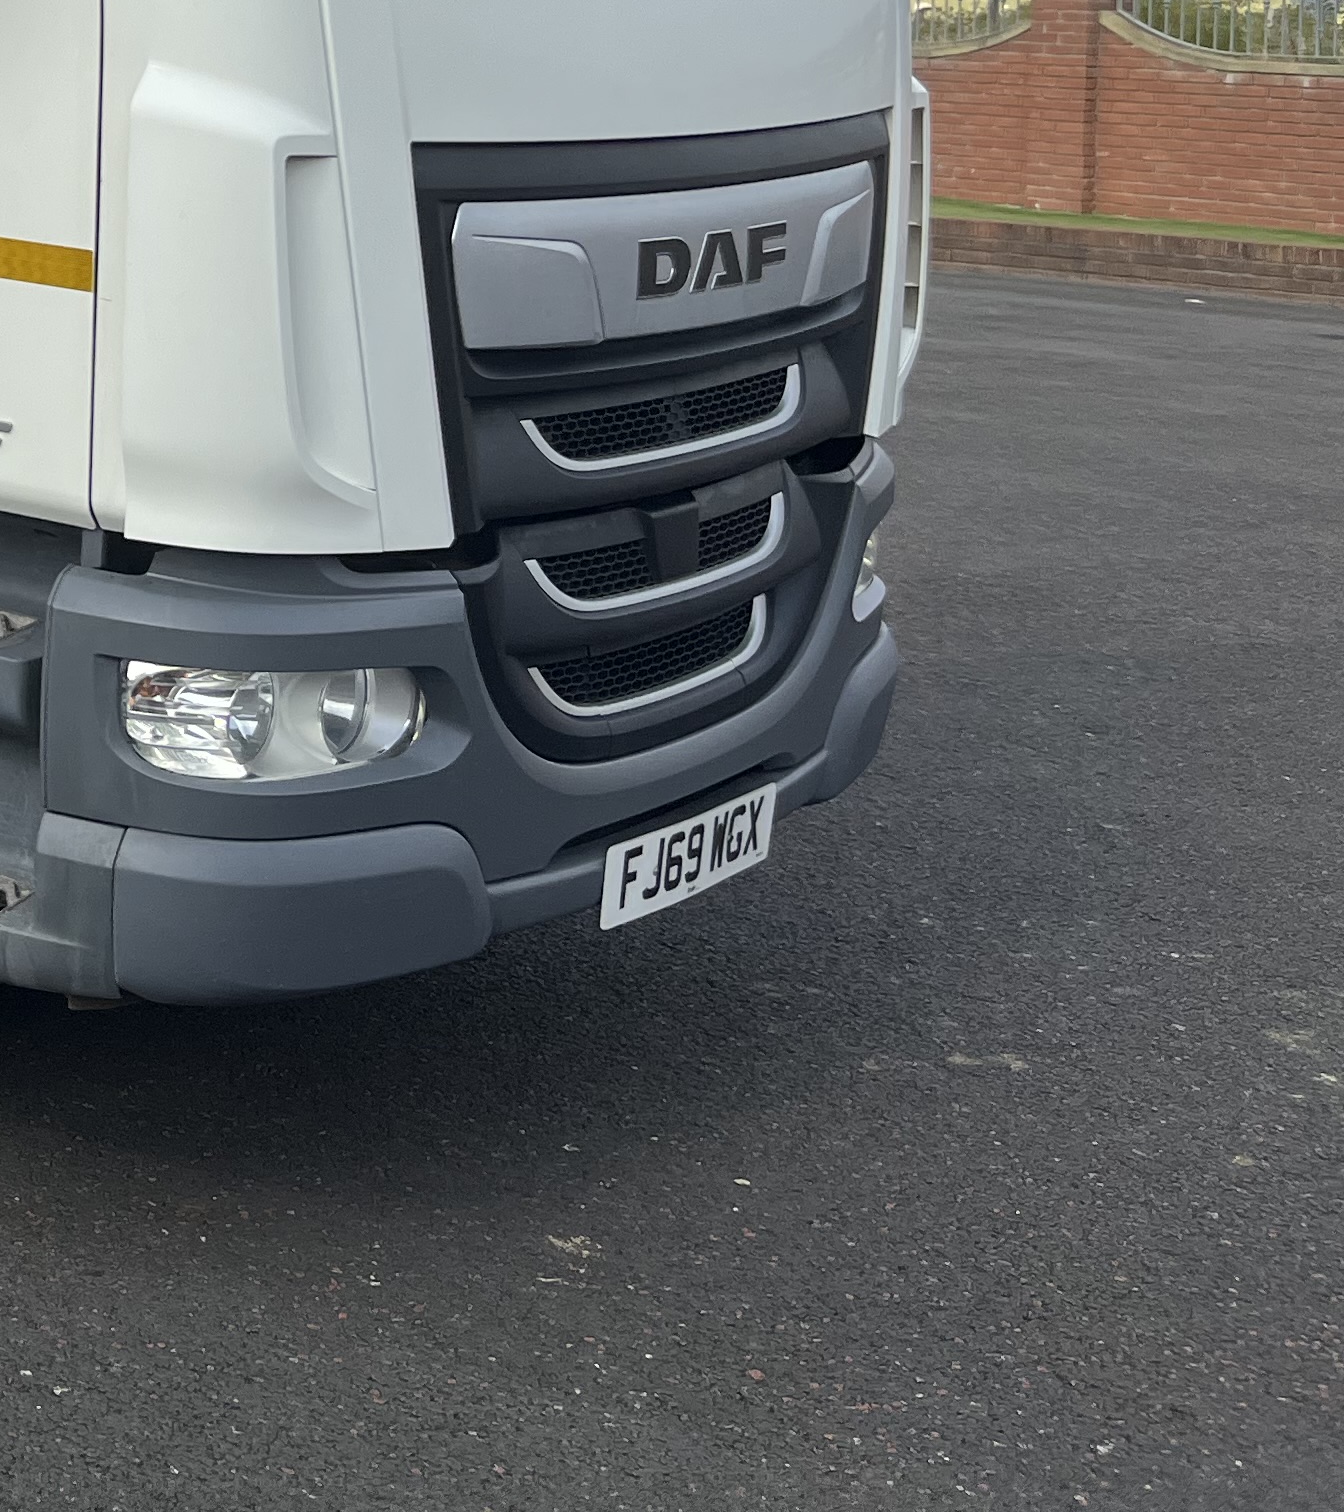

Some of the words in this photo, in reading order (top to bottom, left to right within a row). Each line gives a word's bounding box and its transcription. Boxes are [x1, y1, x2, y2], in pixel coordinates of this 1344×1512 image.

[636, 220, 787, 300] DAF
[619, 823, 705, 910] FJ69
[709, 795, 765, 873] WGX
